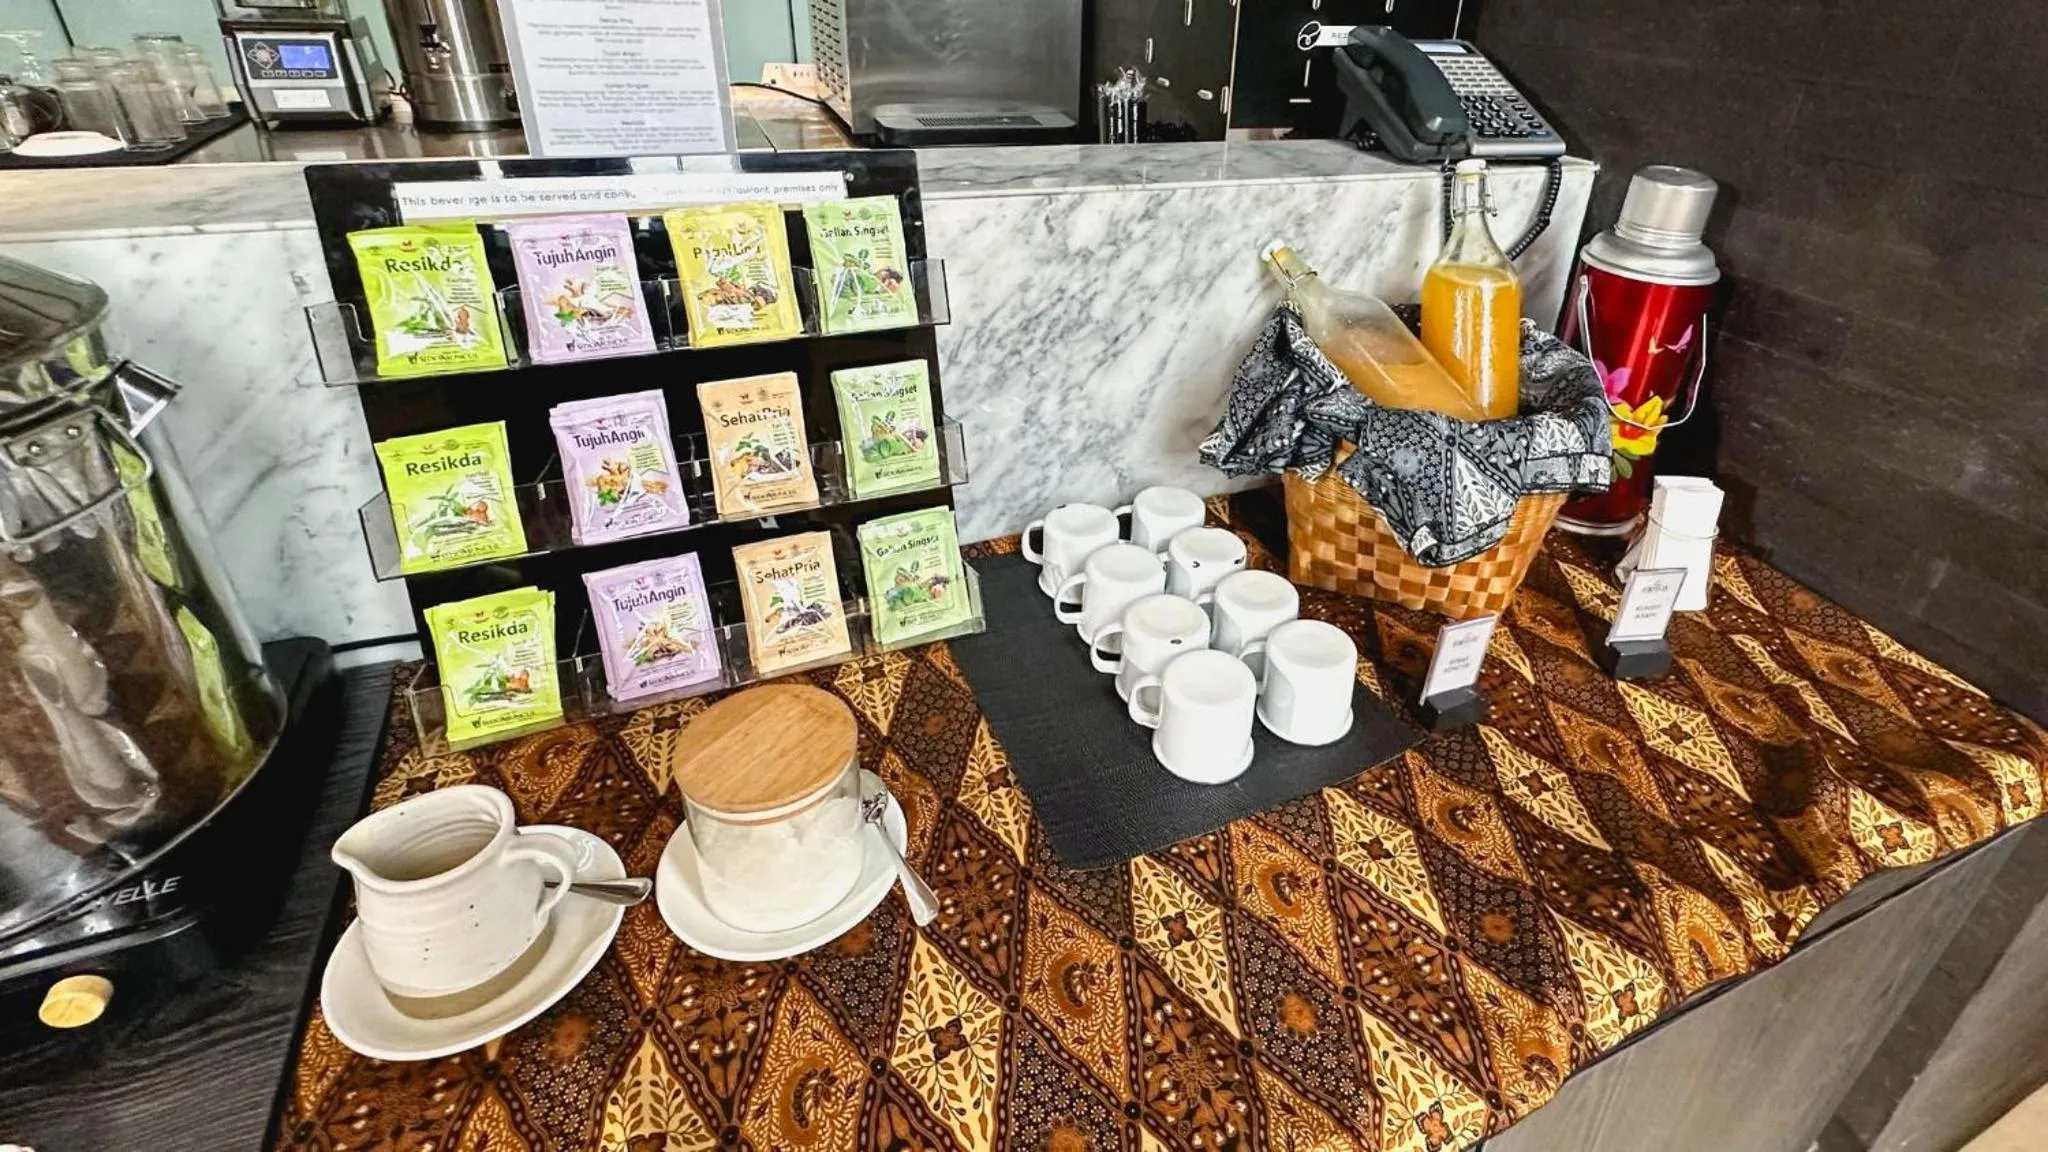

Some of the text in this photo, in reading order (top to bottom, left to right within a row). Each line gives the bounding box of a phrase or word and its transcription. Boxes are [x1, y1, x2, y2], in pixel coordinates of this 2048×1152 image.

[402, 197, 426, 206] This
[504, 195, 517, 203] to
[580, 190, 602, 201] and
[773, 184, 816, 195] premises
[819, 183, 839, 193] only
[405, 453, 482, 476] Resikda
[458, 620, 528, 643] Resikda
